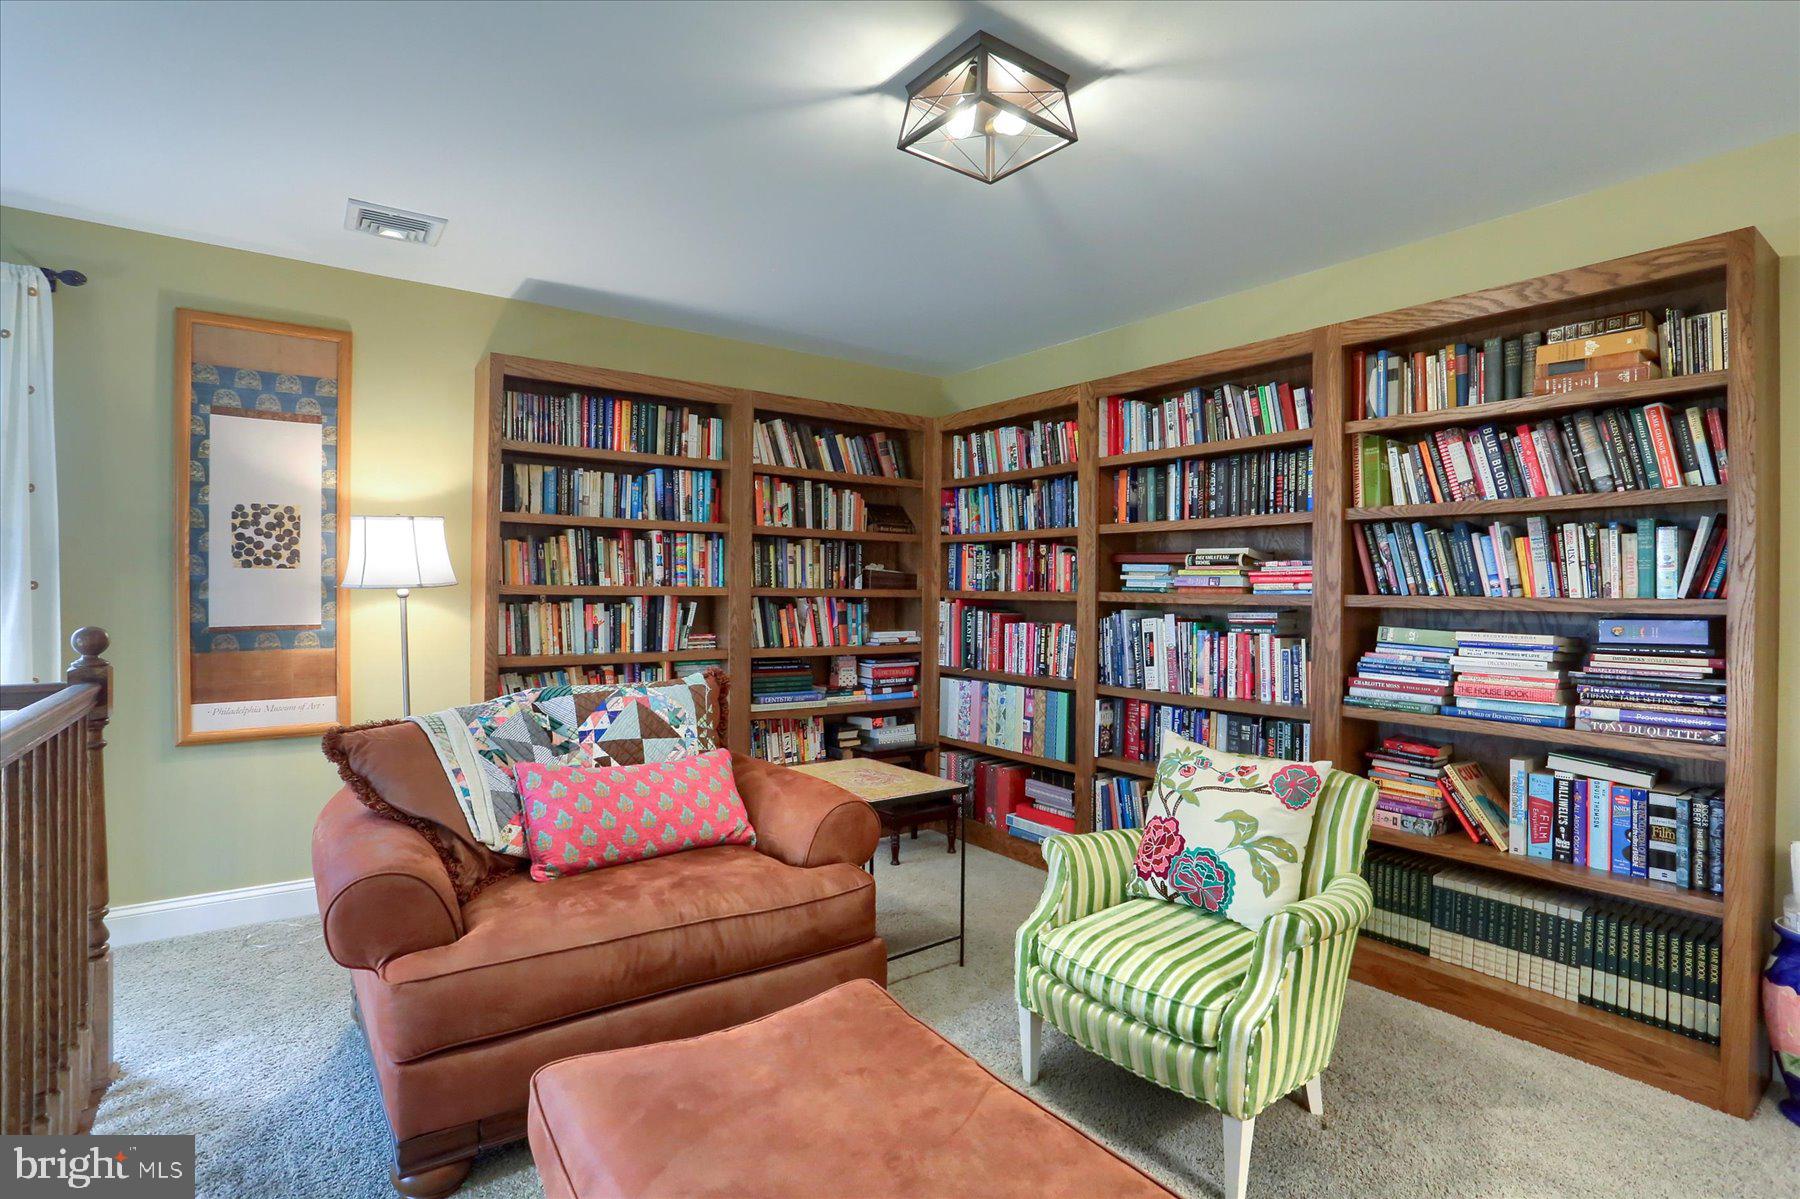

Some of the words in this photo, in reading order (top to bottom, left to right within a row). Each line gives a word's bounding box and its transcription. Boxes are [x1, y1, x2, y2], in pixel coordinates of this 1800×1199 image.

[1482, 427, 1498, 454] BLUE
[1492, 459, 1508, 492] BLOOD
[1353, 680, 1385, 688] CHARLOTTE
[1458, 686, 1473, 694] THE
[1474, 687, 1502, 696] HOUSE
[1504, 690, 1529, 698] BOOK
[1590, 686, 1625, 695] INSTANT
[1586, 692, 1614, 700] TIFFANY
[212, 706, 261, 716] Philadelphia
[264, 704, 296, 713] Museum
[298, 703, 305, 713] of
[307, 702, 321, 711] Art
[1468, 710, 1484, 718] WORLD
[1492, 713, 1522, 722] DEPARTMENT
[1636, 713, 1674, 723] Provence
[1676, 717, 1712, 726] Interiors
[1590, 721, 1624, 732] TONY
[1629, 723, 1703, 740] DUQUETTE
[1267, 738, 1275, 757] WAR
[1558, 780, 1569, 825] HALLIWELL'S
[1693, 803, 1701, 826] EBERT
[1701, 803, 1709, 827] ROGER
[1539, 814, 1549, 839] FILM
[1651, 826, 1676, 842] Film
[1584, 916, 1592, 930] YEAR
[1657, 951, 1665, 970] BOOK
[1684, 958, 1692, 977] BOOK
